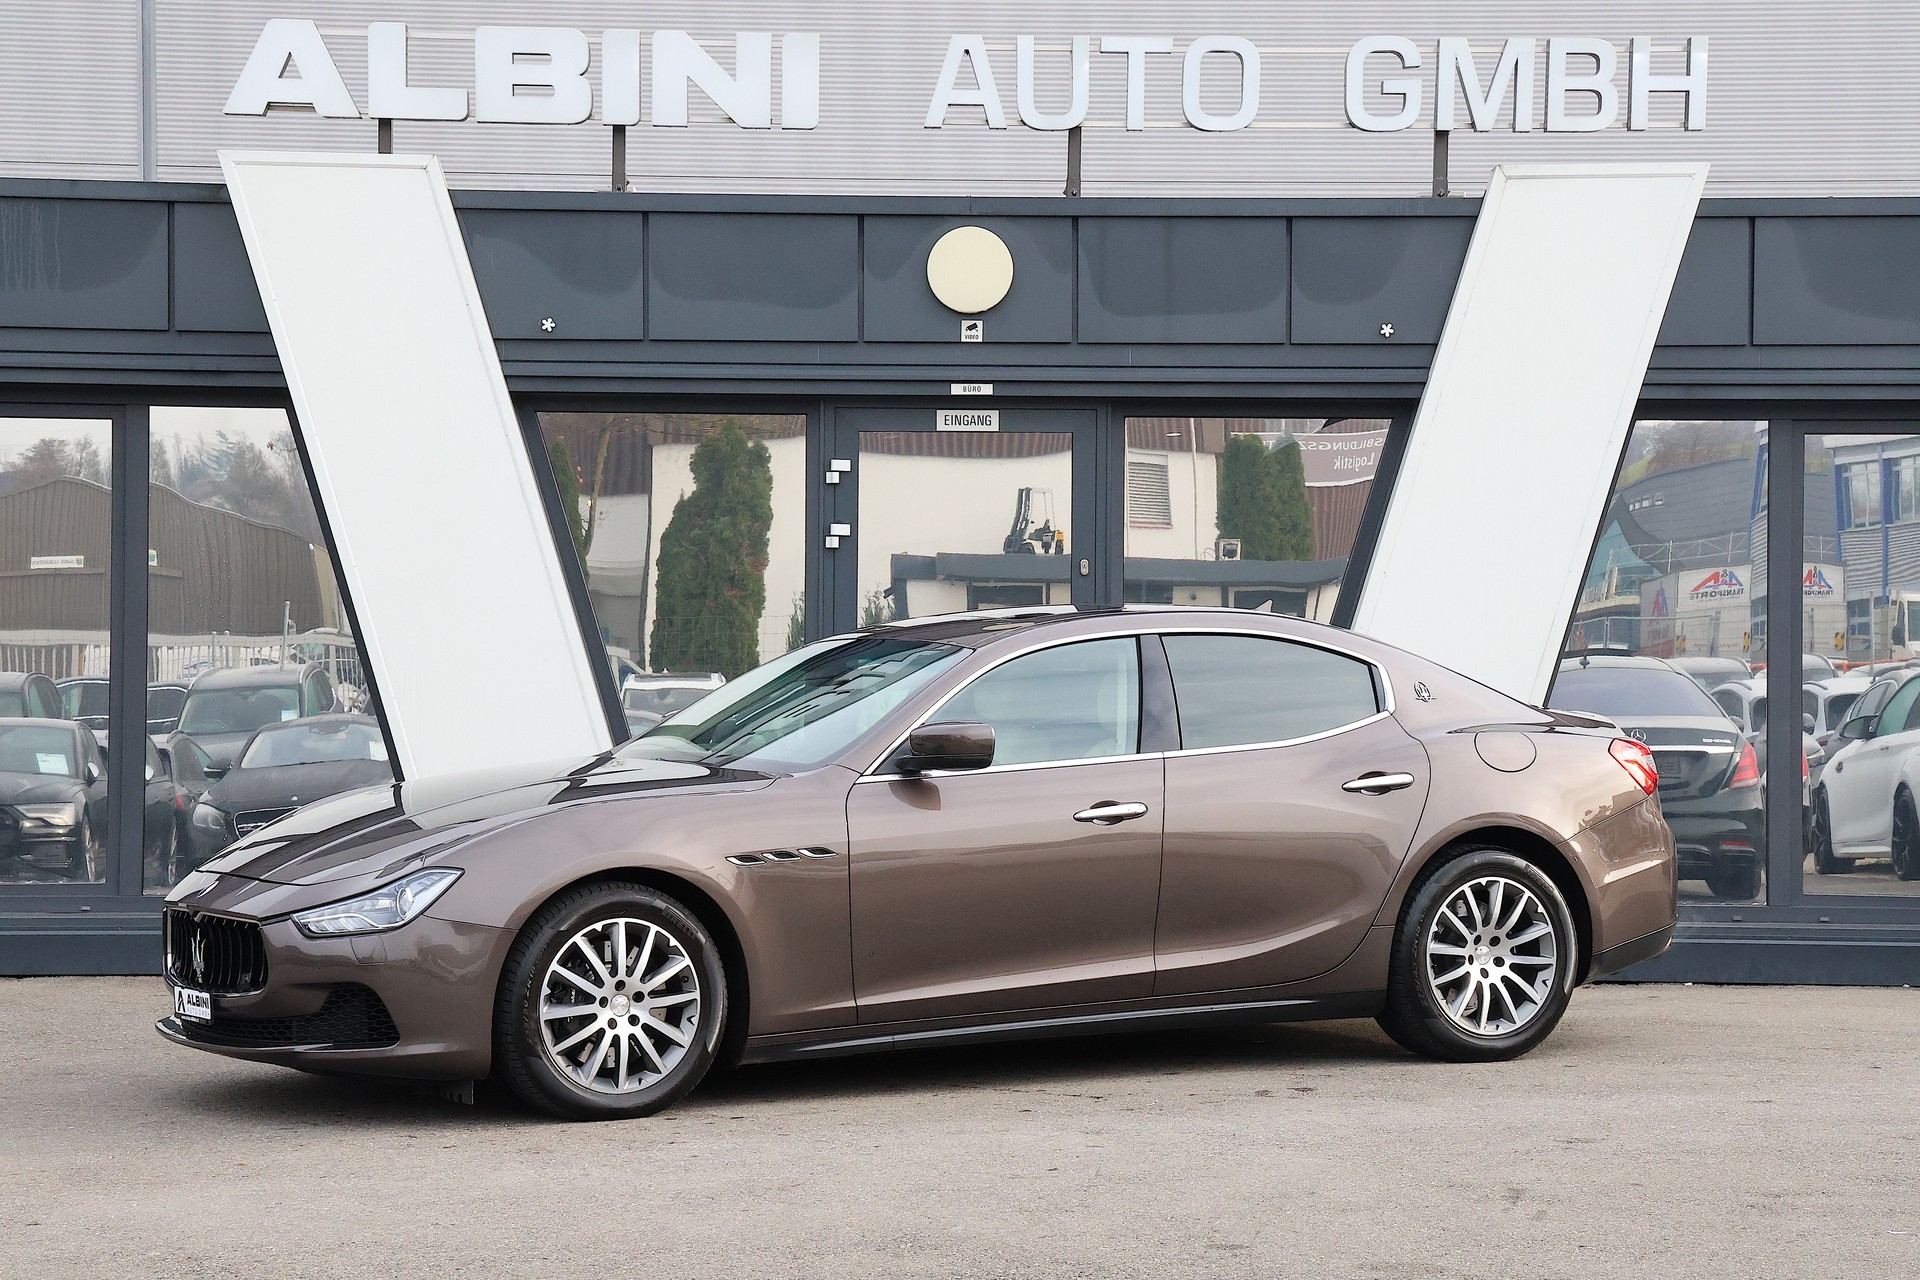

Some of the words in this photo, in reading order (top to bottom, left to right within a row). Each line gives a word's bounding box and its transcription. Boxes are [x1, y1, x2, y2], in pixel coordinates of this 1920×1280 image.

[222, 18, 821, 131] ALBINI
[923, 34, 1262, 133] AUTO
[1343, 35, 1709, 134] GMBH
[962, 385, 982, 393] BÜRO
[944, 414, 992, 427] EINGANG
[187, 994, 209, 1009] ALBINI
